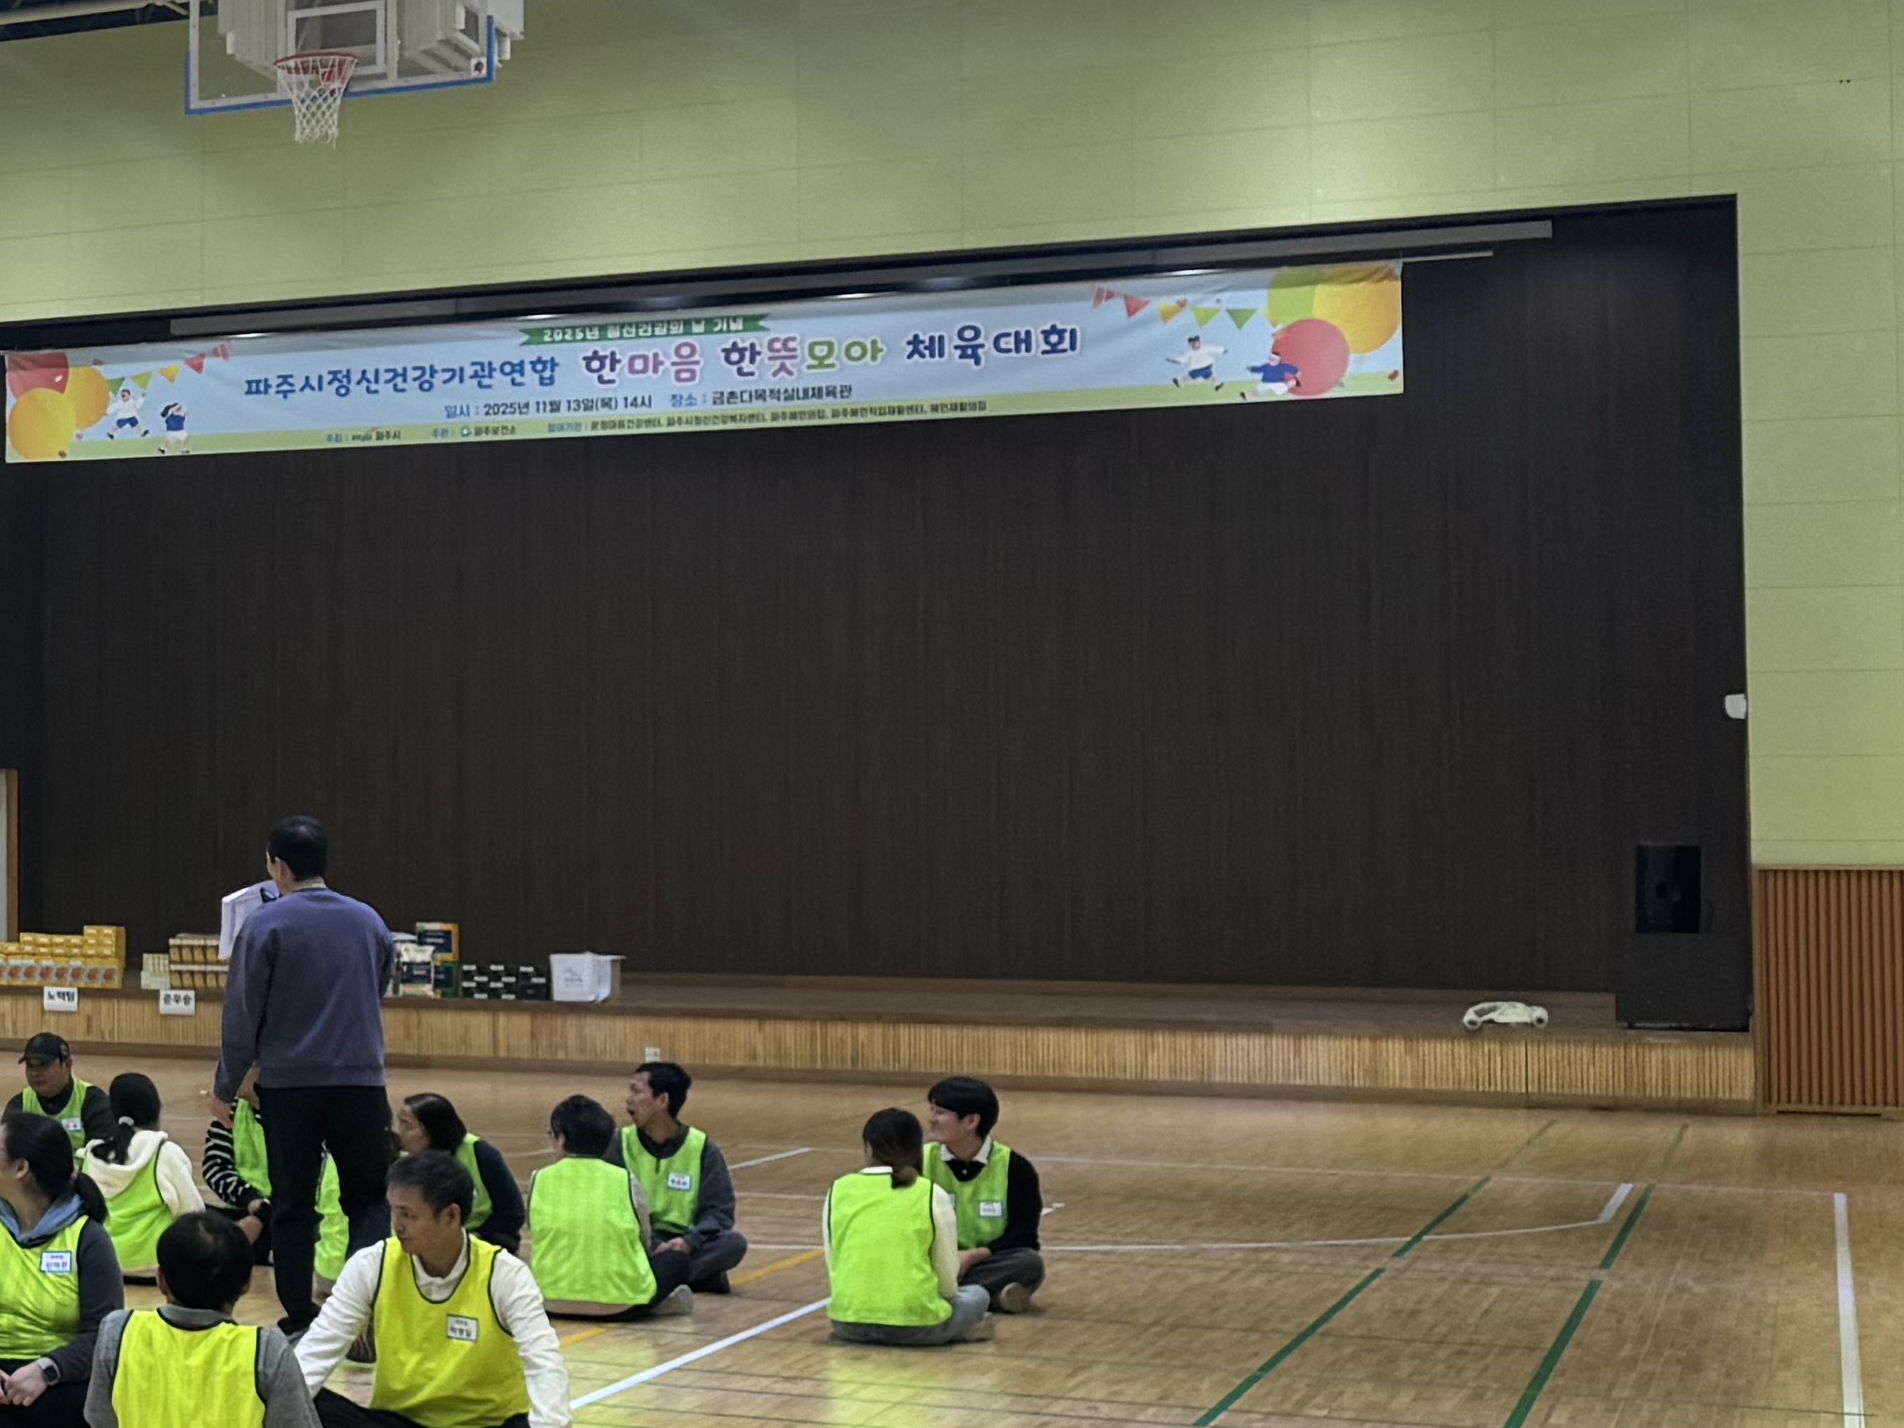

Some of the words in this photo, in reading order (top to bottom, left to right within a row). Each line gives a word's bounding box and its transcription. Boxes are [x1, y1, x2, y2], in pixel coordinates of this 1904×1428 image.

[544, 327, 599, 342] 2025년
[245, 355, 559, 399] 파주시정신건강기관연합
[583, 341, 700, 385] 한마음
[721, 336, 883, 378] 한뜻모아
[905, 324, 1078, 367] 체육대회
[445, 403, 470, 417] 일시
[483, 400, 530, 416] 2025년
[535, 399, 561, 414] 11월
[566, 395, 618, 413] 13일(목)
[623, 395, 652, 410] 14시
[670, 393, 697, 408] 장소
[711, 384, 853, 407] 금촌다목적실내체육관
